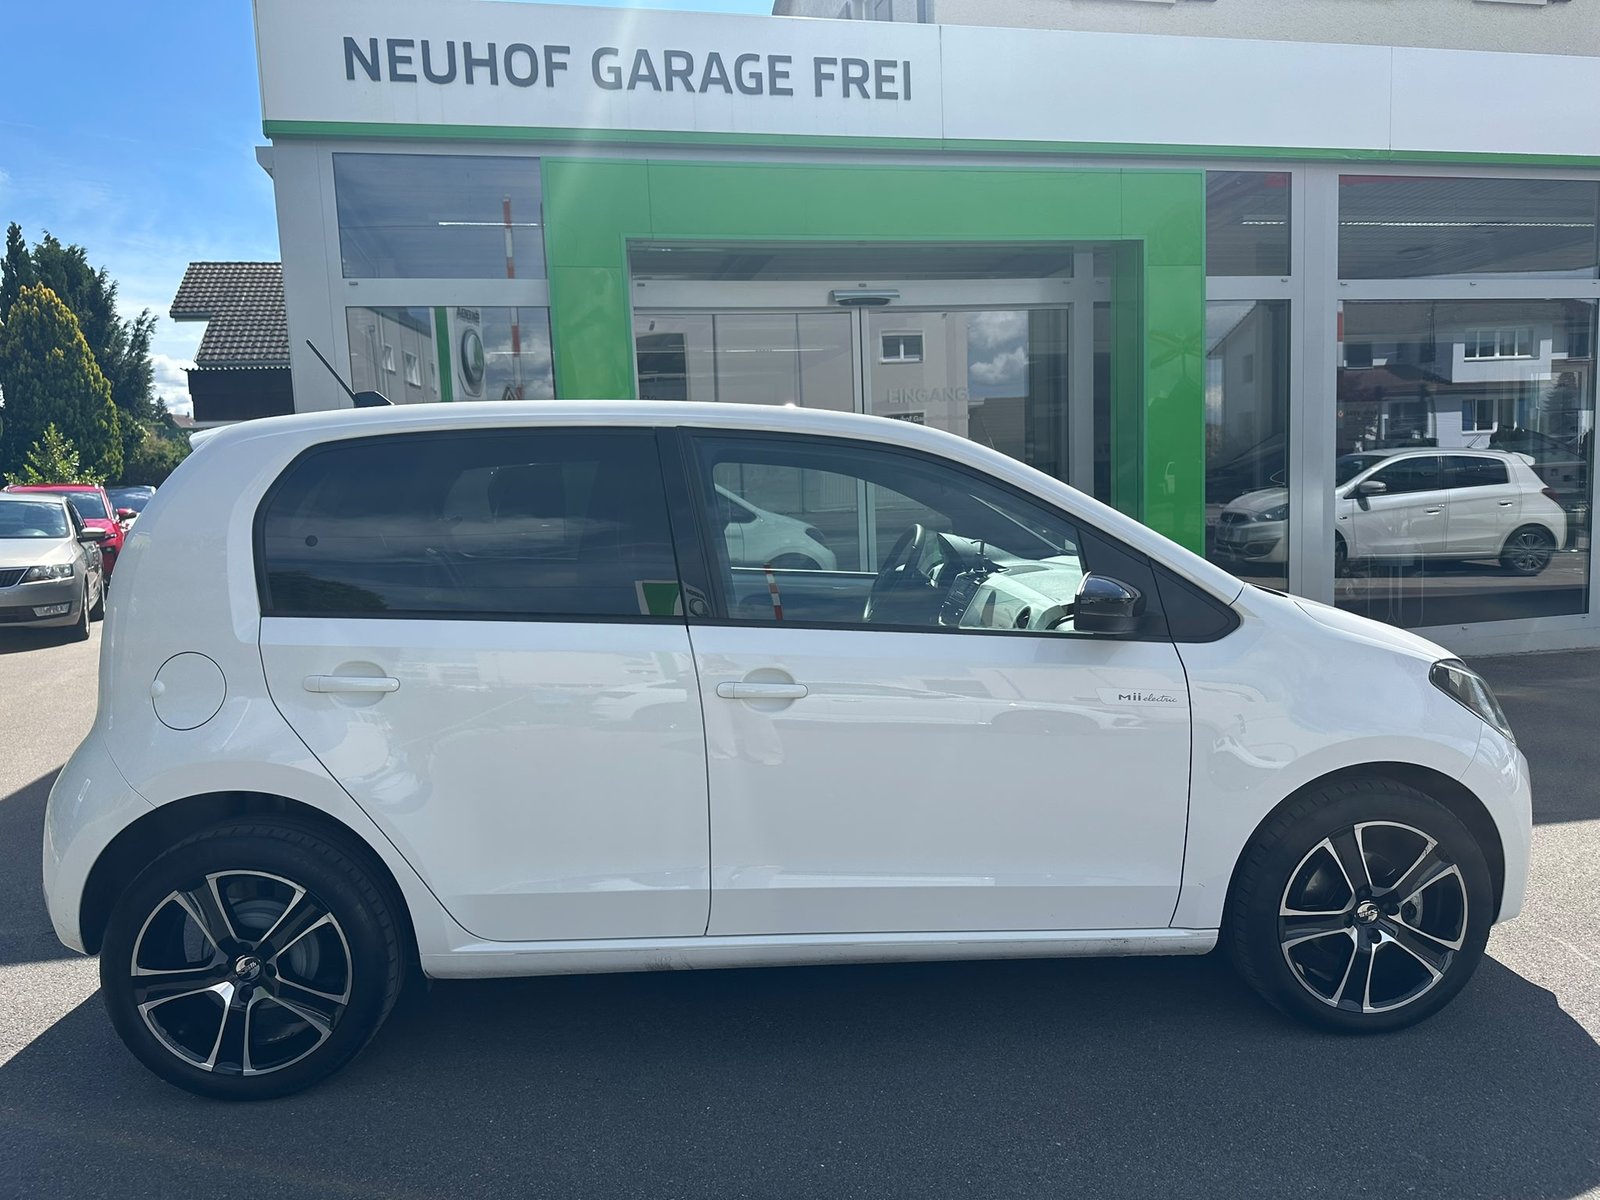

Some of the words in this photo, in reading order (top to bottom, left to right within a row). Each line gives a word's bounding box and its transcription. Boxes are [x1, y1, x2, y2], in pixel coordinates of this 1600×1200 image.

[343, 37, 571, 88] NEUHOF
[591, 47, 794, 97] GARAGE
[813, 57, 912, 101] FREI
[888, 387, 967, 403] EINGANG
[1143, 693, 1177, 703] electric
